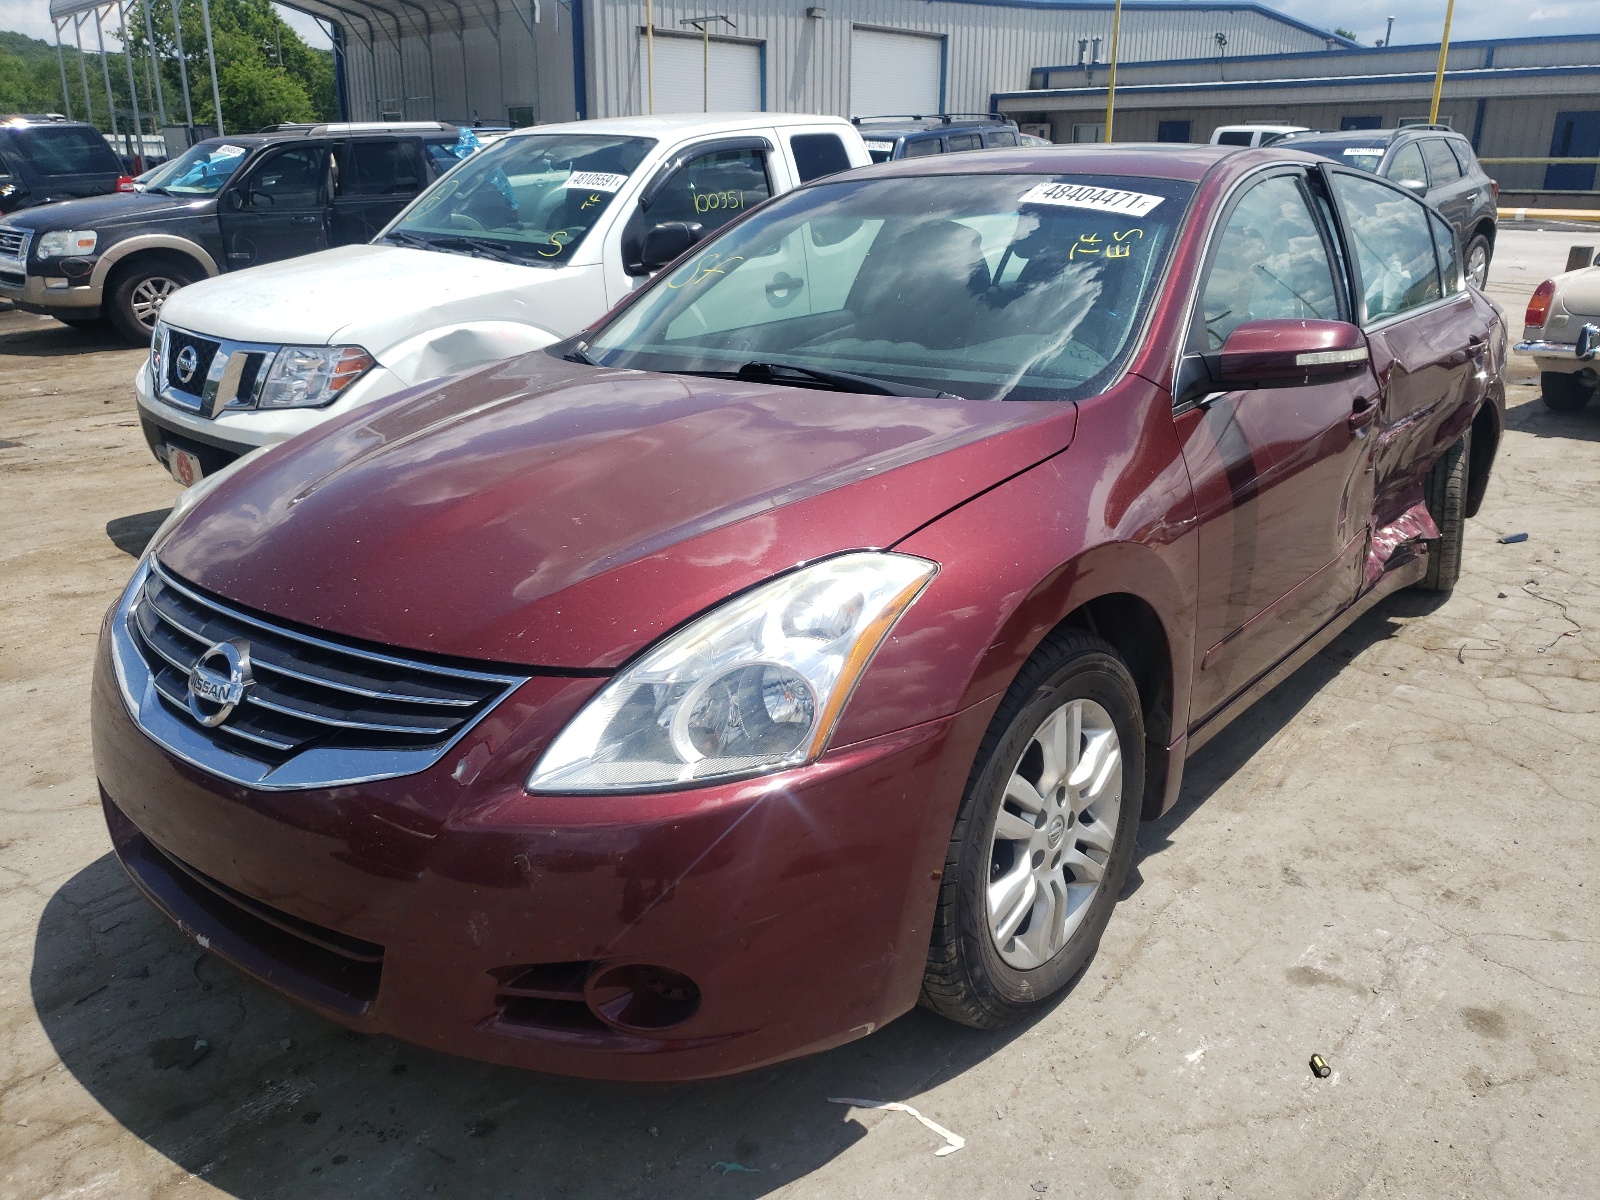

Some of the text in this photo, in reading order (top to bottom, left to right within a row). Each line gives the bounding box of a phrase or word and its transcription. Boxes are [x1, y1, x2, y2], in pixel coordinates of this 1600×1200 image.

[573, 173, 619, 186] 48105591
[693, 190, 745, 215] 100351
[1043, 184, 1144, 208] 48404471
[1136, 200, 1150, 209] F
[537, 231, 568, 257] S
[190, 671, 232, 700] NISSAN
